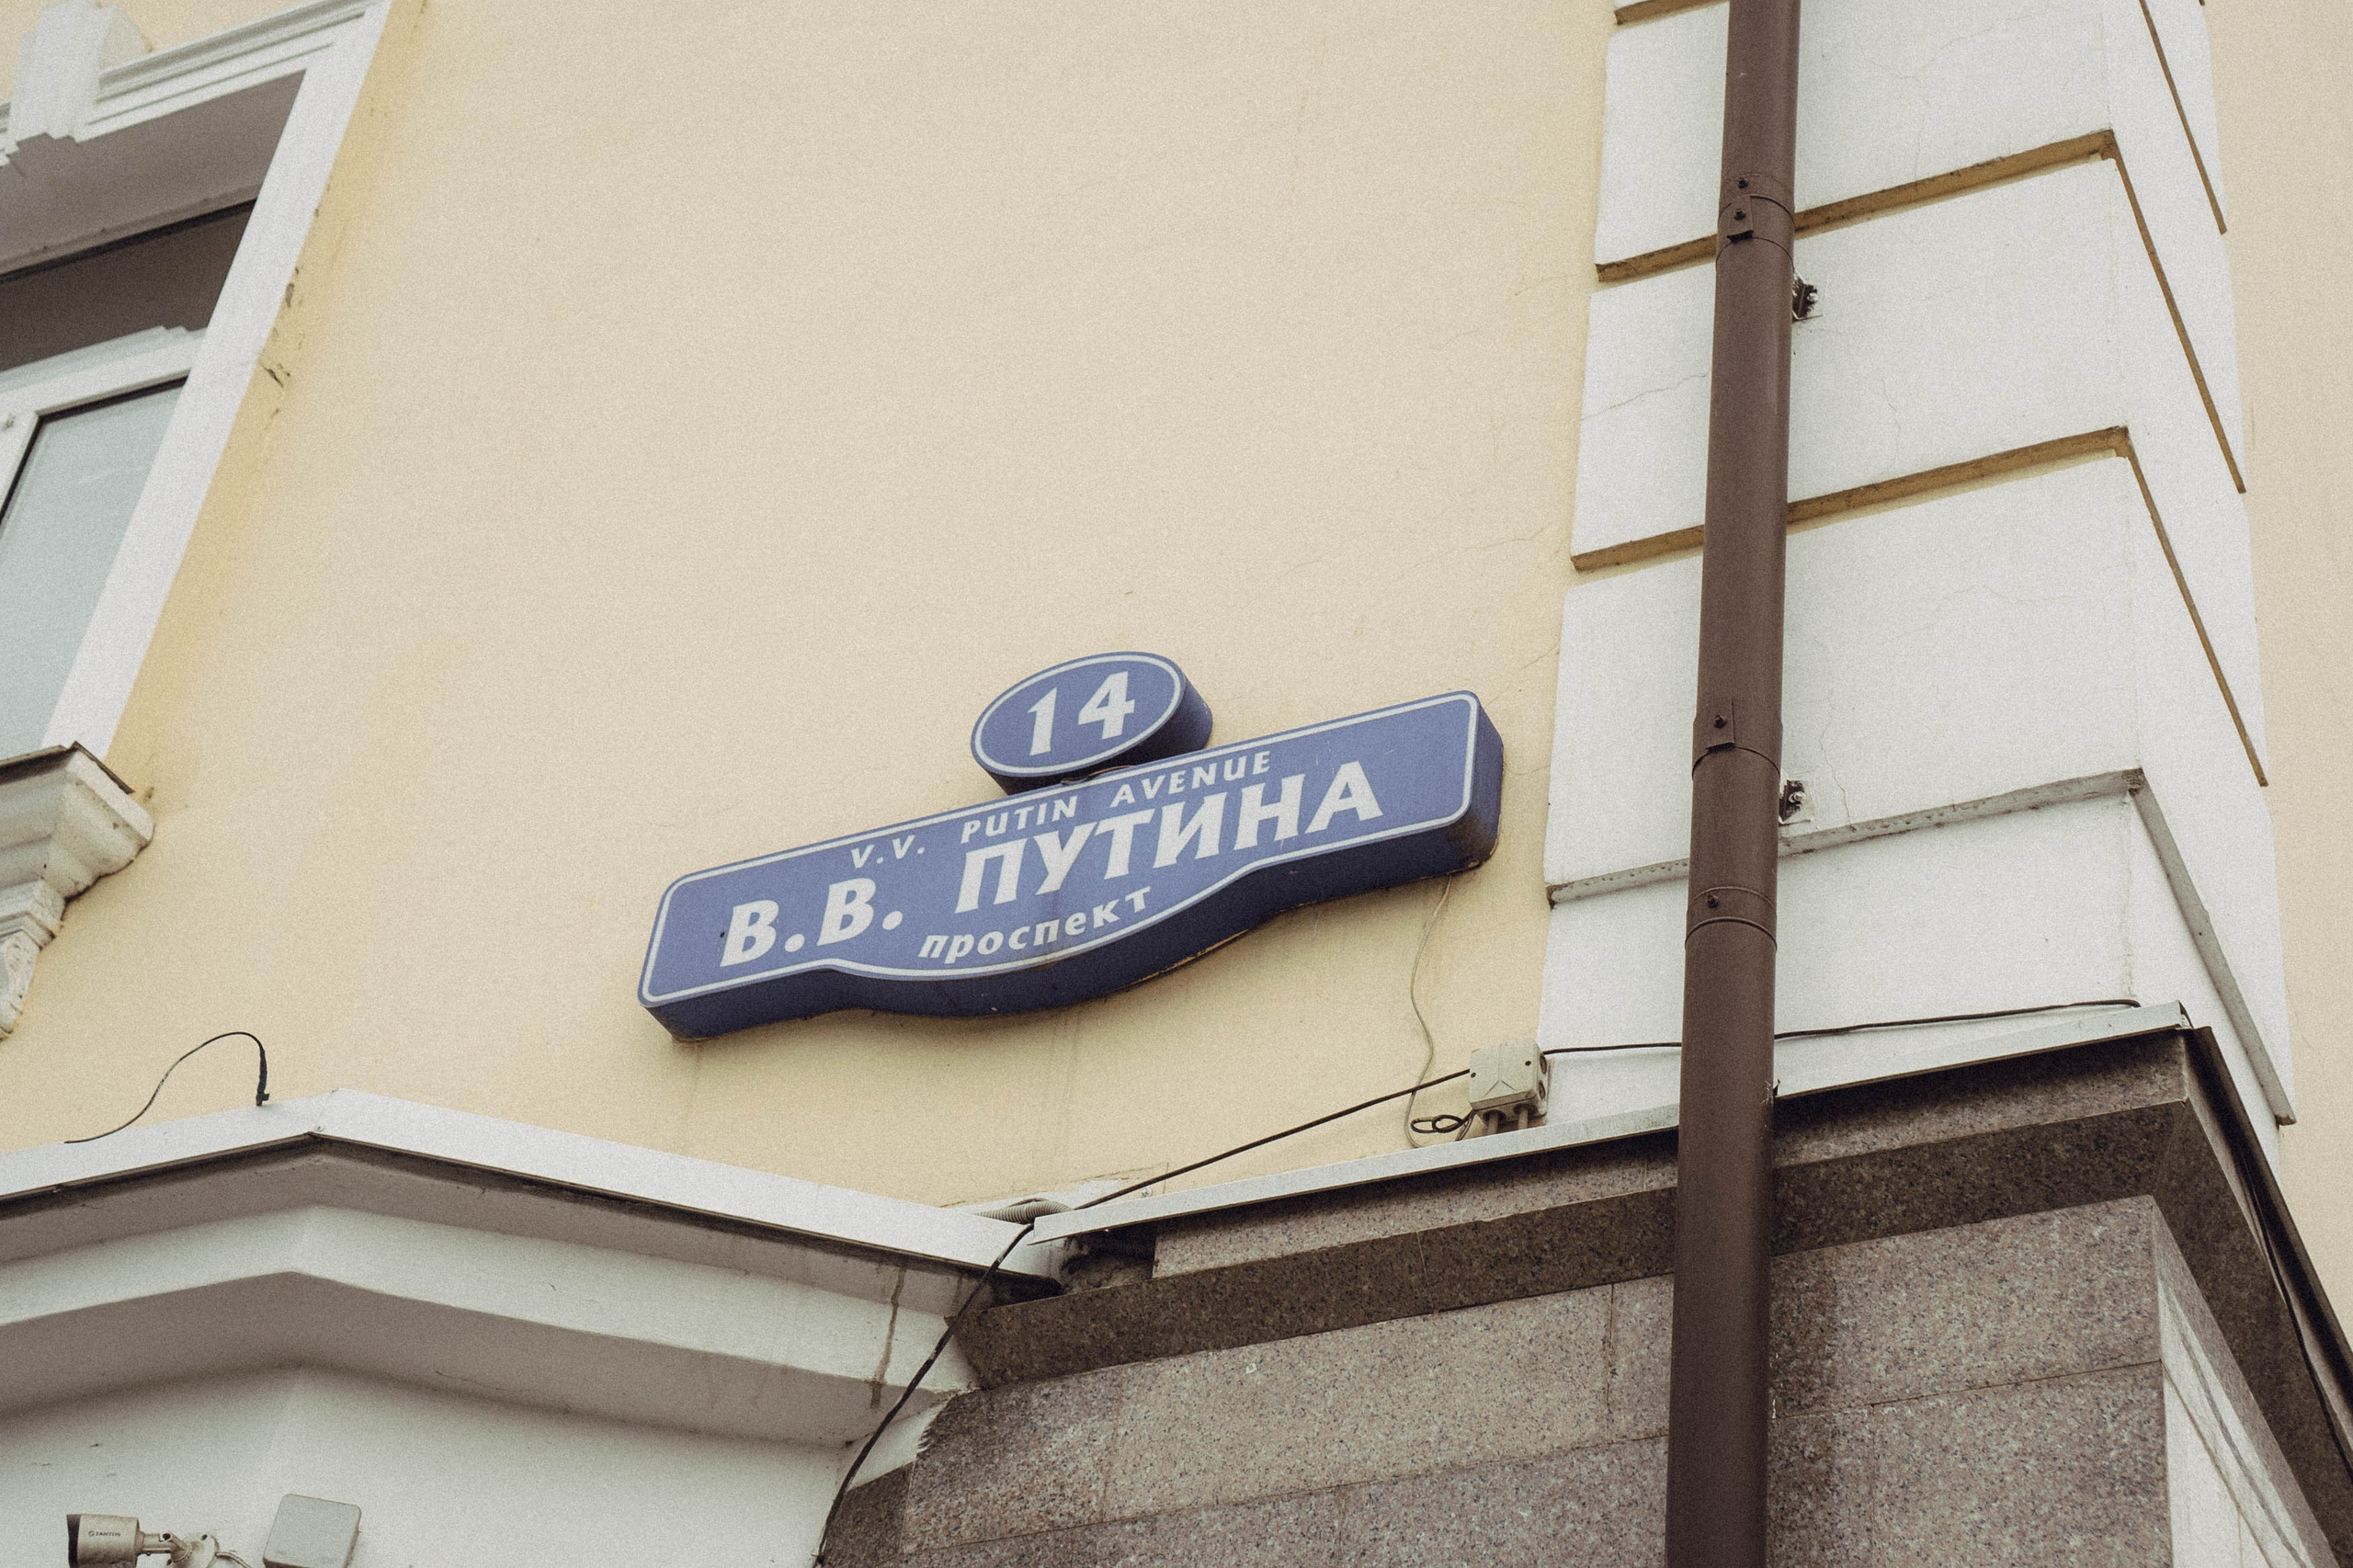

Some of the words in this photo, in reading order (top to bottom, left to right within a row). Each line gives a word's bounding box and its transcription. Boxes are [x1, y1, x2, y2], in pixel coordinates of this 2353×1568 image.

[1028, 672, 1135, 756] 14
[955, 761, 1383, 914] ПУТИНА
[961, 796, 1077, 844] PUTIN
[1109, 752, 1270, 808] AVENUE
[918, 887, 1151, 964] проспект
